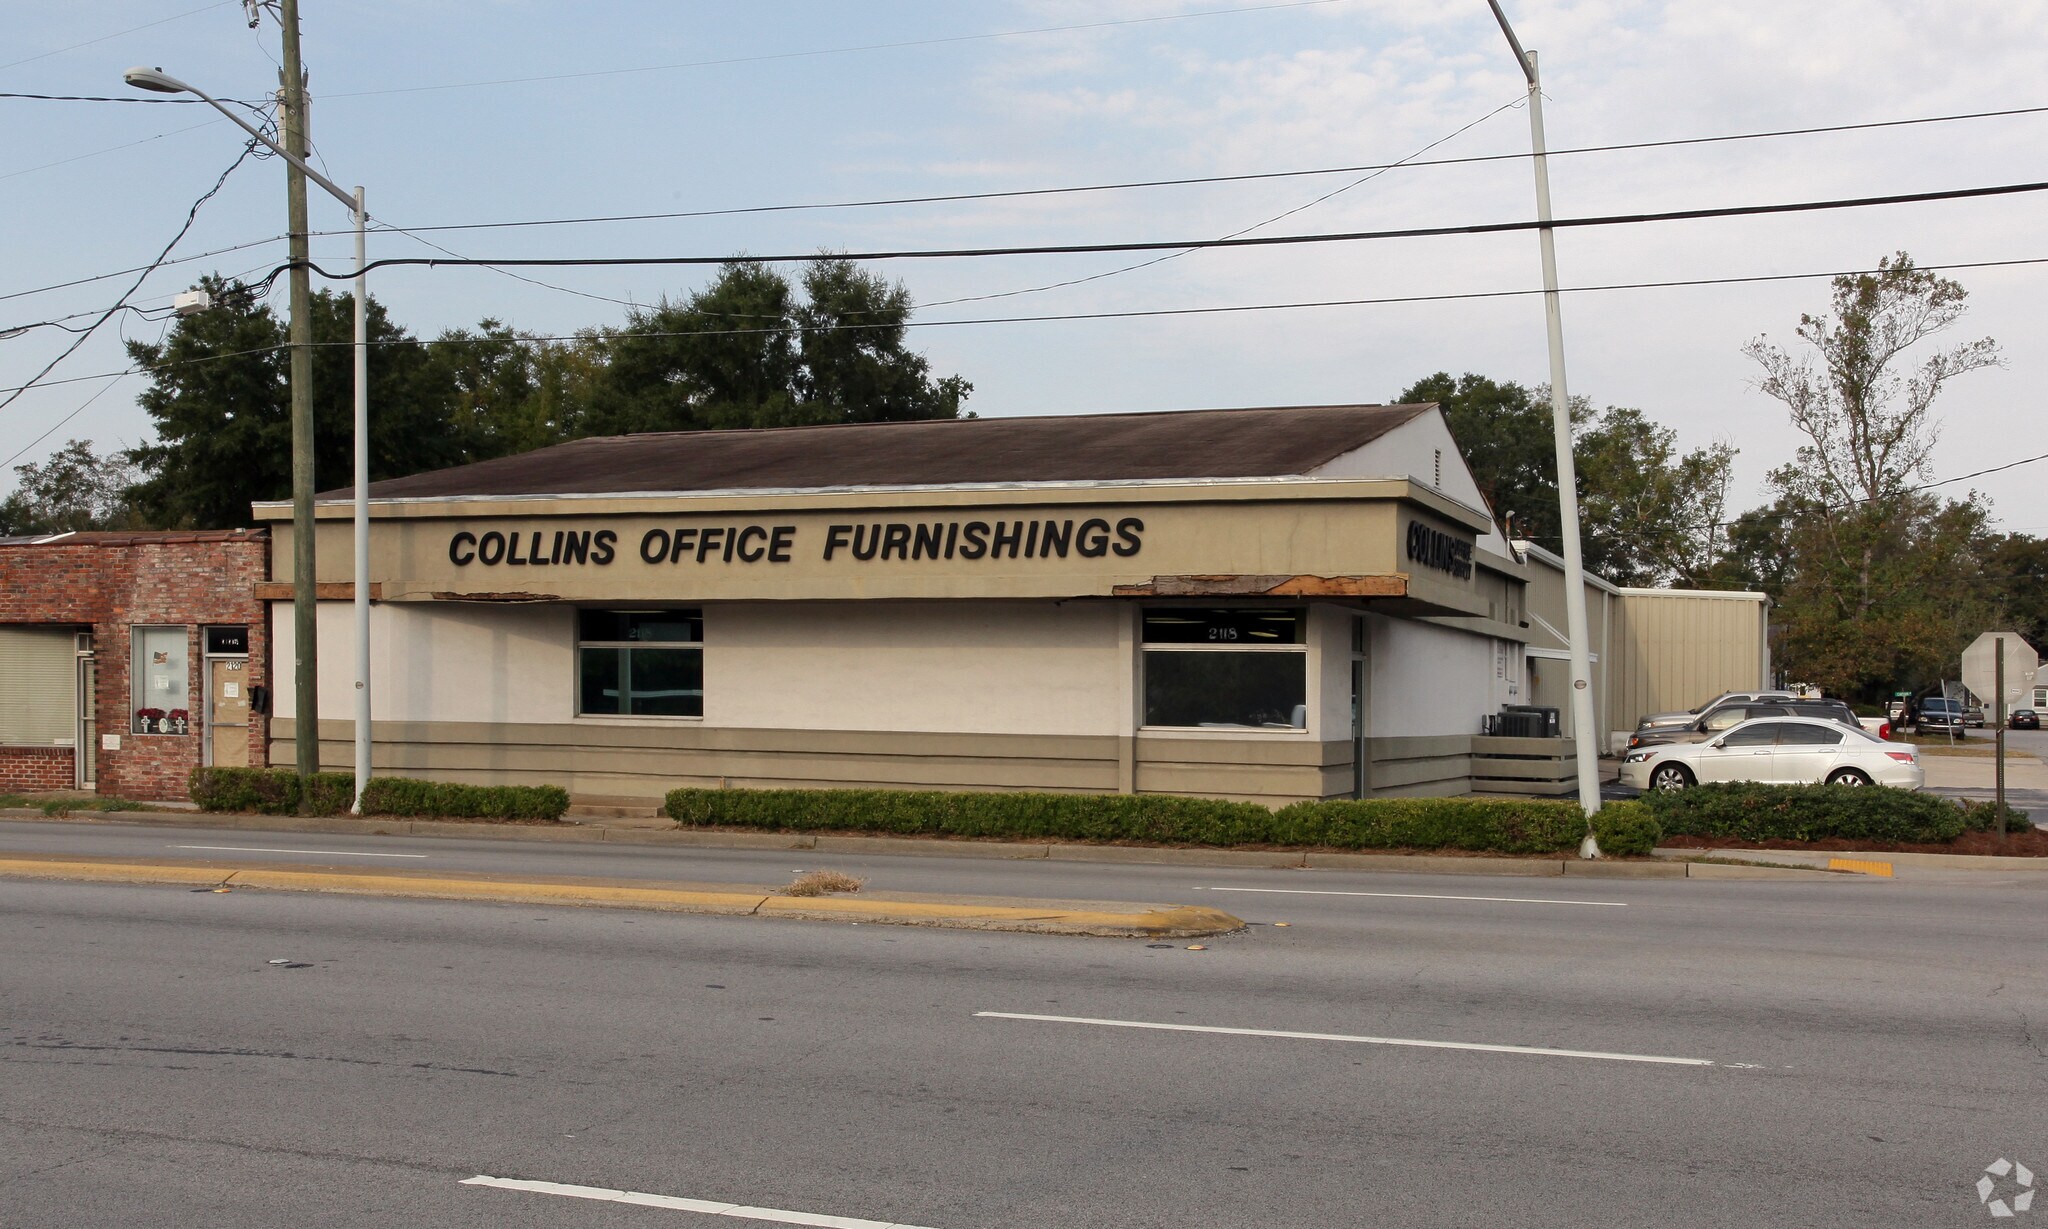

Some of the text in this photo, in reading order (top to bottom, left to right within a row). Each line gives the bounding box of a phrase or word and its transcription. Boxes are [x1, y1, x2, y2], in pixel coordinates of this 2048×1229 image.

[449, 517, 1145, 567] COLLINS OFFICE FURNISHINGS
[1406, 520, 1456, 573] COLLINS
[1208, 627, 1238, 640] 2118
